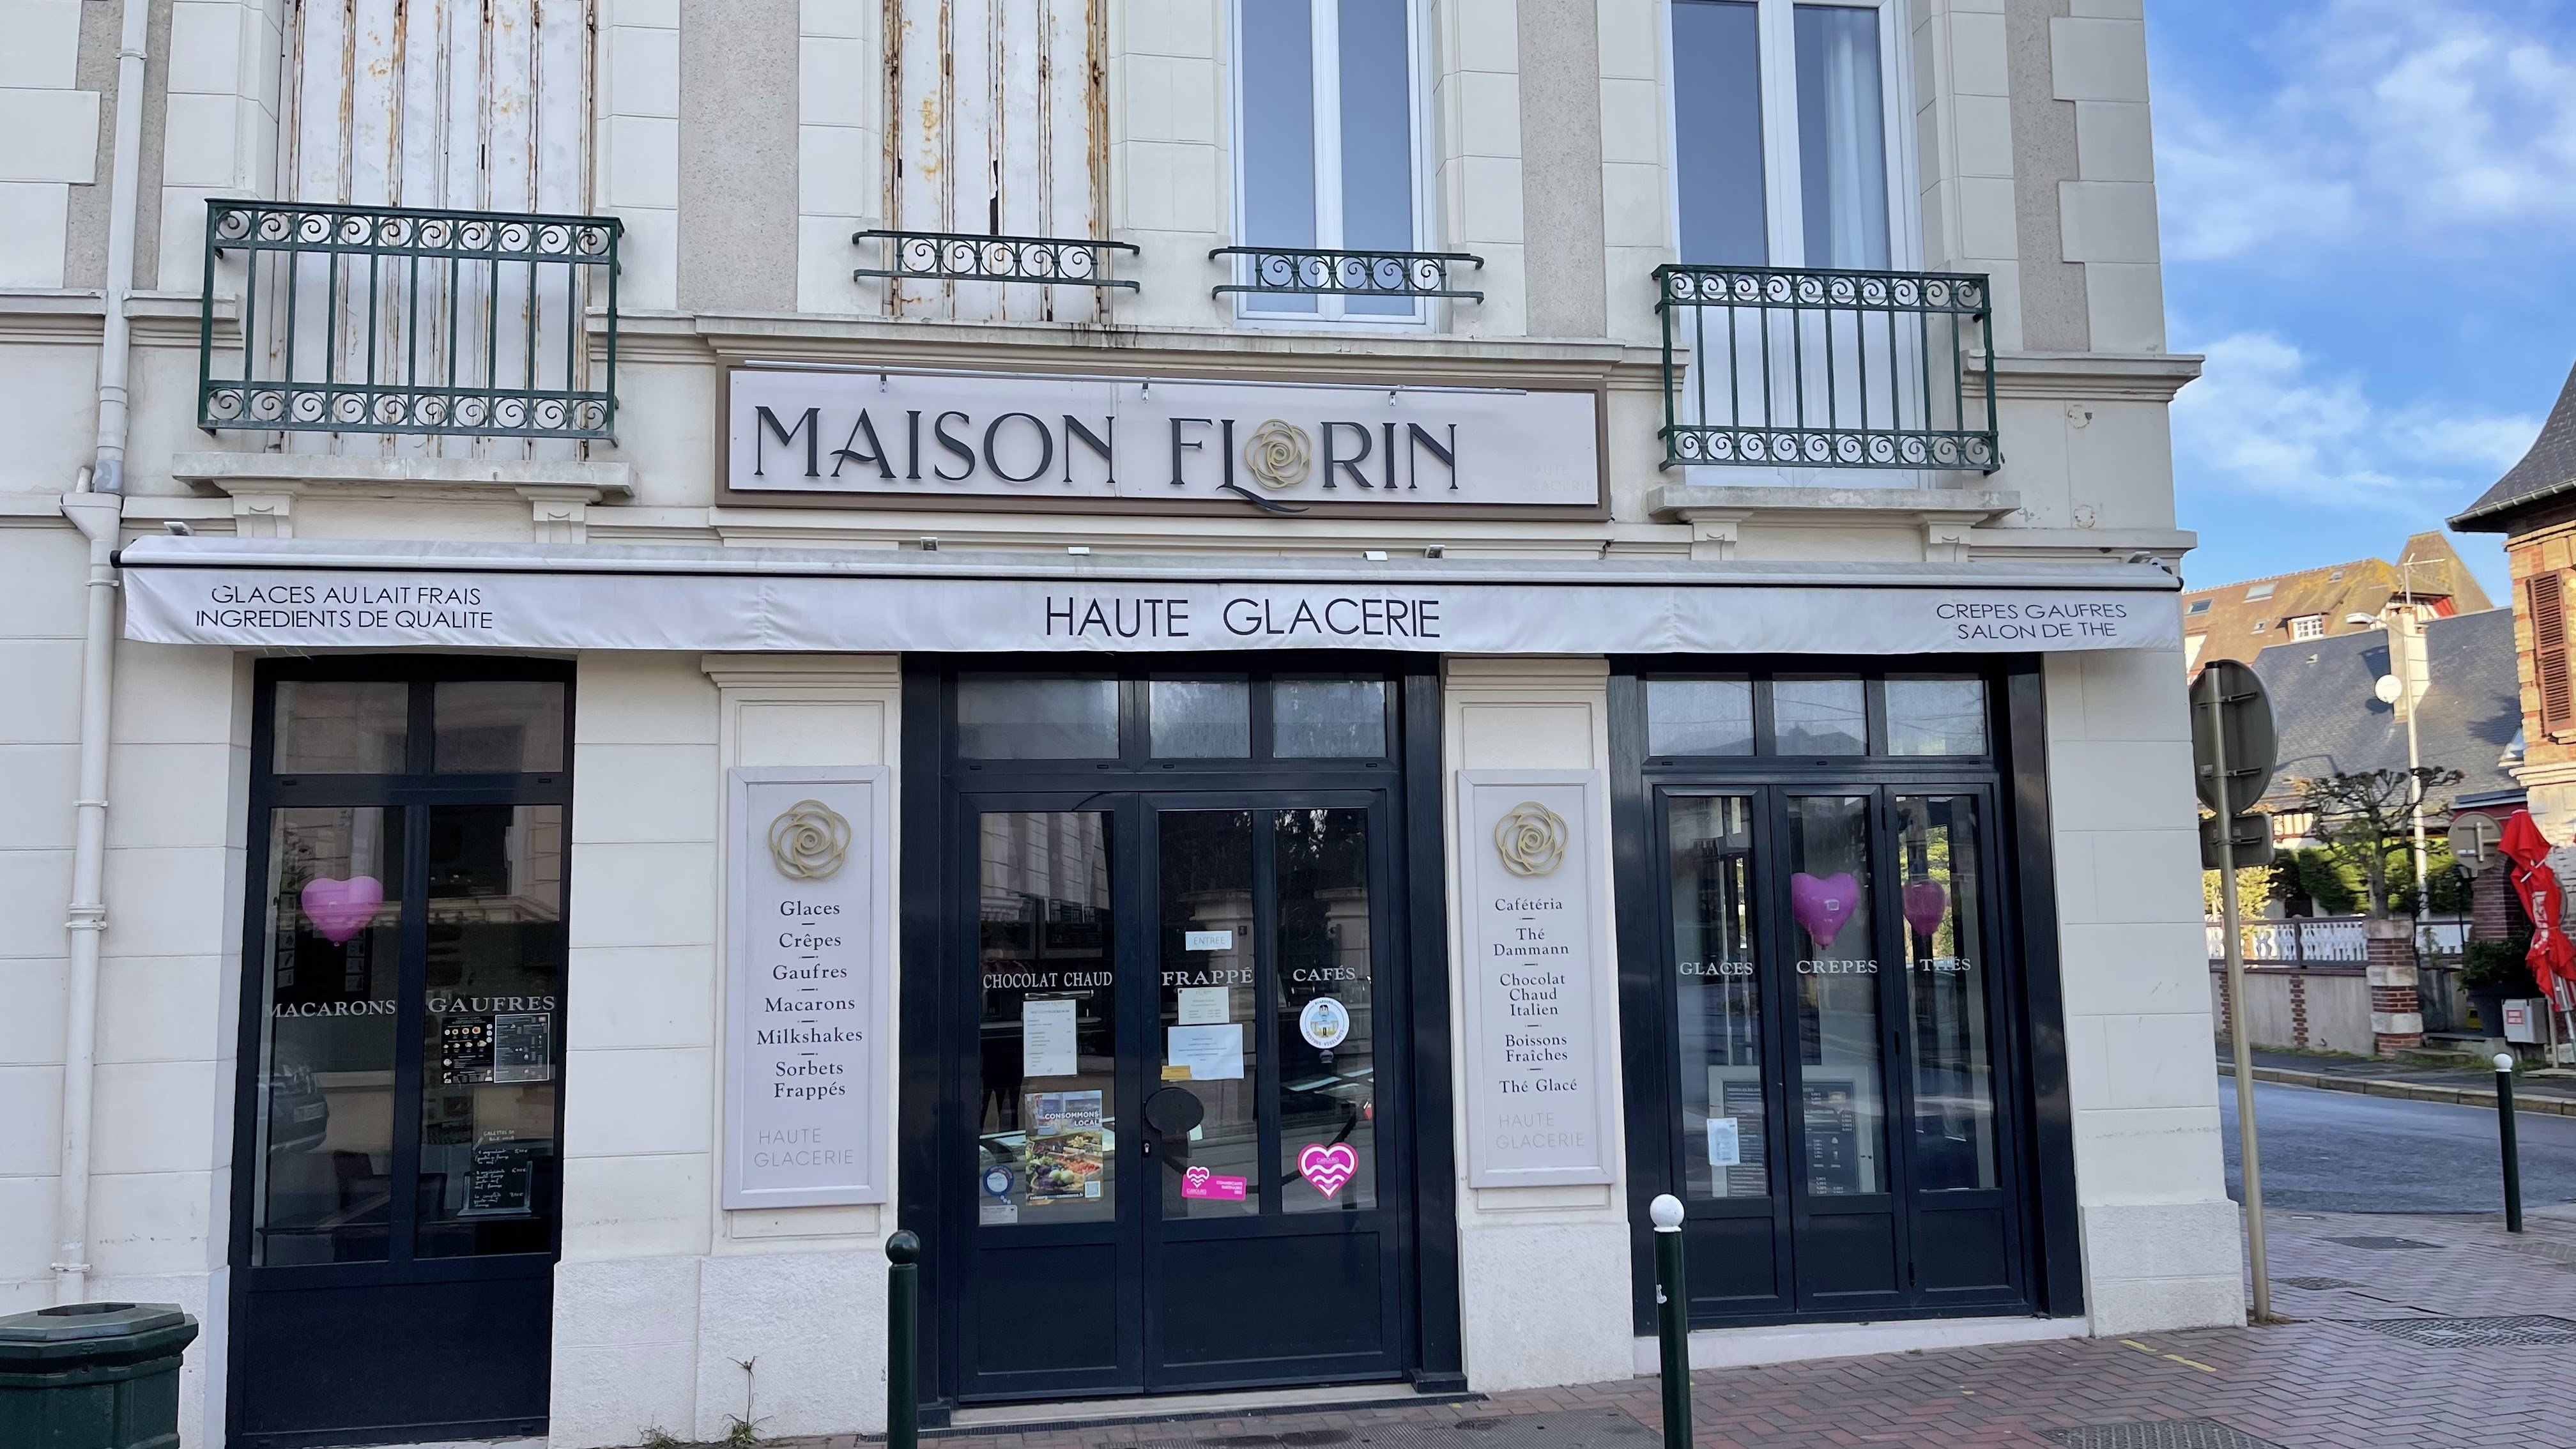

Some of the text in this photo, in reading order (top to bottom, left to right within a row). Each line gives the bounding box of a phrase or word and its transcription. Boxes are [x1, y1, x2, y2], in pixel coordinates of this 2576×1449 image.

[755, 406, 1458, 512] MAISON FLORIN
[211, 586, 480, 605] GLACES AU LAIT FRAIS
[196, 610, 493, 629] INGREDIENTS DE QUALITE
[1046, 596, 1440, 638] HAUTE GLACERIE
[1936, 604, 2127, 619] CREPES GAUFRES
[1958, 622, 2117, 640] SALON DE THE
[780, 900, 840, 916] Glaces
[1495, 898, 1563, 911] Cafétéria
[779, 933, 841, 951] Crêpes
[1515, 928, 1545, 940] Thé
[1494, 944, 1569, 956] Dammann
[772, 963, 847, 980] Gaufres
[1292, 965, 1356, 982] CAFÉS
[1679, 962, 1754, 976] GLACES
[1796, 960, 1878, 974] CREPES
[983, 971, 1113, 989] CHOCOLAT CHAUD
[1162, 967, 1254, 986] FRAPPÉ
[1500, 972, 1565, 986] Chocolat
[1509, 987, 1557, 1001] Chaud
[264, 999, 396, 1018] MACARONS
[428, 995, 555, 1013] GAUFRES
[765, 997, 855, 1013] Macarons
[1510, 1003, 1559, 1016] Italien
[756, 1027, 862, 1045] Milkshakes
[1505, 1034, 1567, 1047] Boissons
[1506, 1048, 1568, 1062] Fraîches
[776, 1060, 843, 1077] Sorbets
[774, 1081, 845, 1100] Frappés
[1499, 1078, 1577, 1093] Thé Glacé
[1045, 1110, 1100, 1120] CONSOMMONS
[1499, 1112, 1554, 1128] HAUTE
[758, 1128, 822, 1145] HAUTE
[1496, 1132, 1585, 1150] GLACERIE
[754, 1149, 854, 1167] GLACERIE
